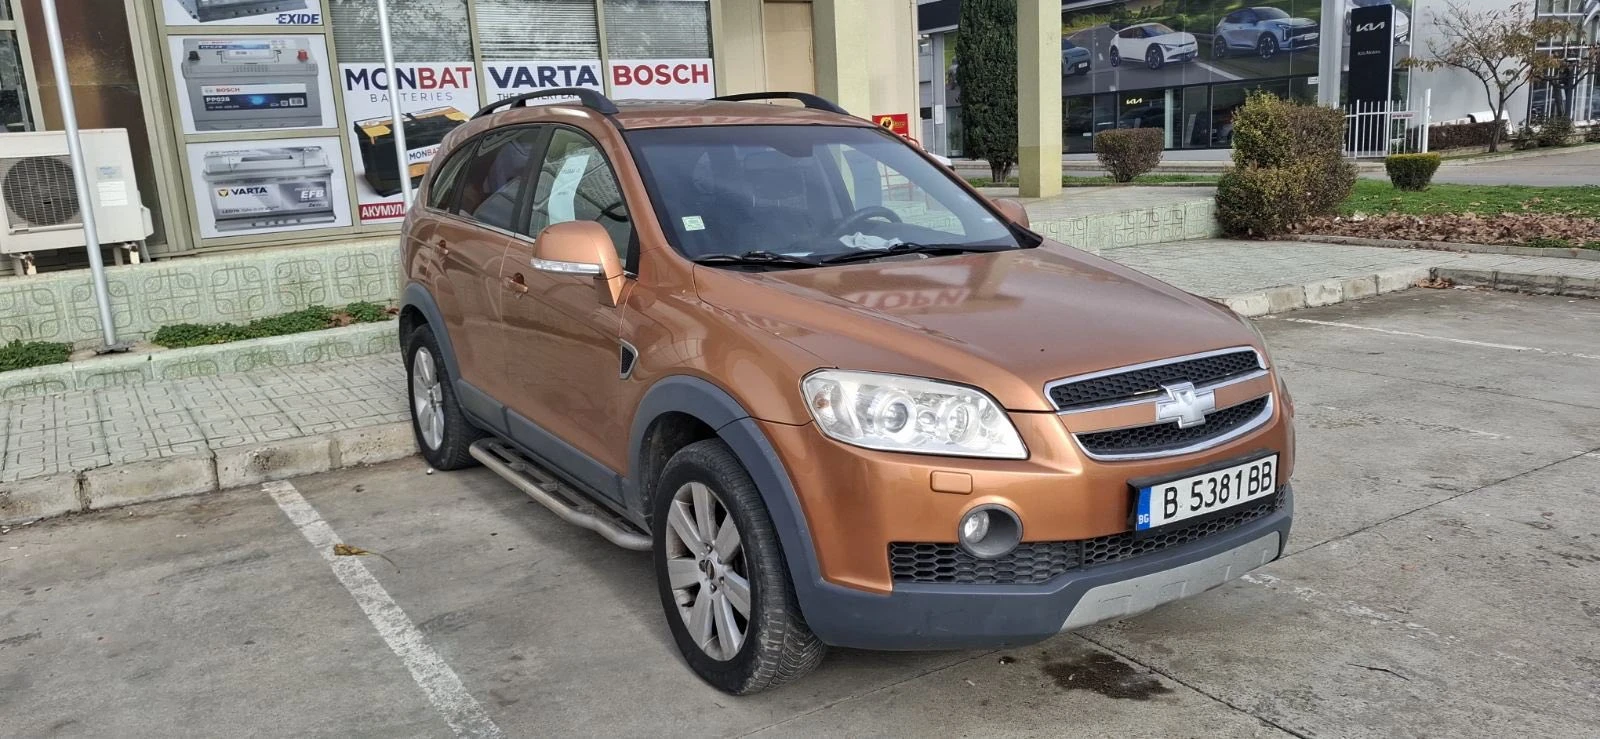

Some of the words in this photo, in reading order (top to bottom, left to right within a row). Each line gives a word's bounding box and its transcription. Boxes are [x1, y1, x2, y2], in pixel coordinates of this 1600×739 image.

[276, 14, 320, 25] EXIDE
[1356, 21, 1385, 32] KIA
[344, 67, 473, 91] MONBAT
[487, 66, 600, 89] VARTA
[612, 63, 709, 87] BOSCH
[369, 92, 454, 103] BATERIES
[231, 187, 268, 196] VARTA
[301, 190, 325, 199] EFB
[1163, 486, 1178, 520] B
[1190, 469, 1243, 512] 5381
[1247, 460, 1273, 497] BB
[1138, 513, 1150, 525] BG
